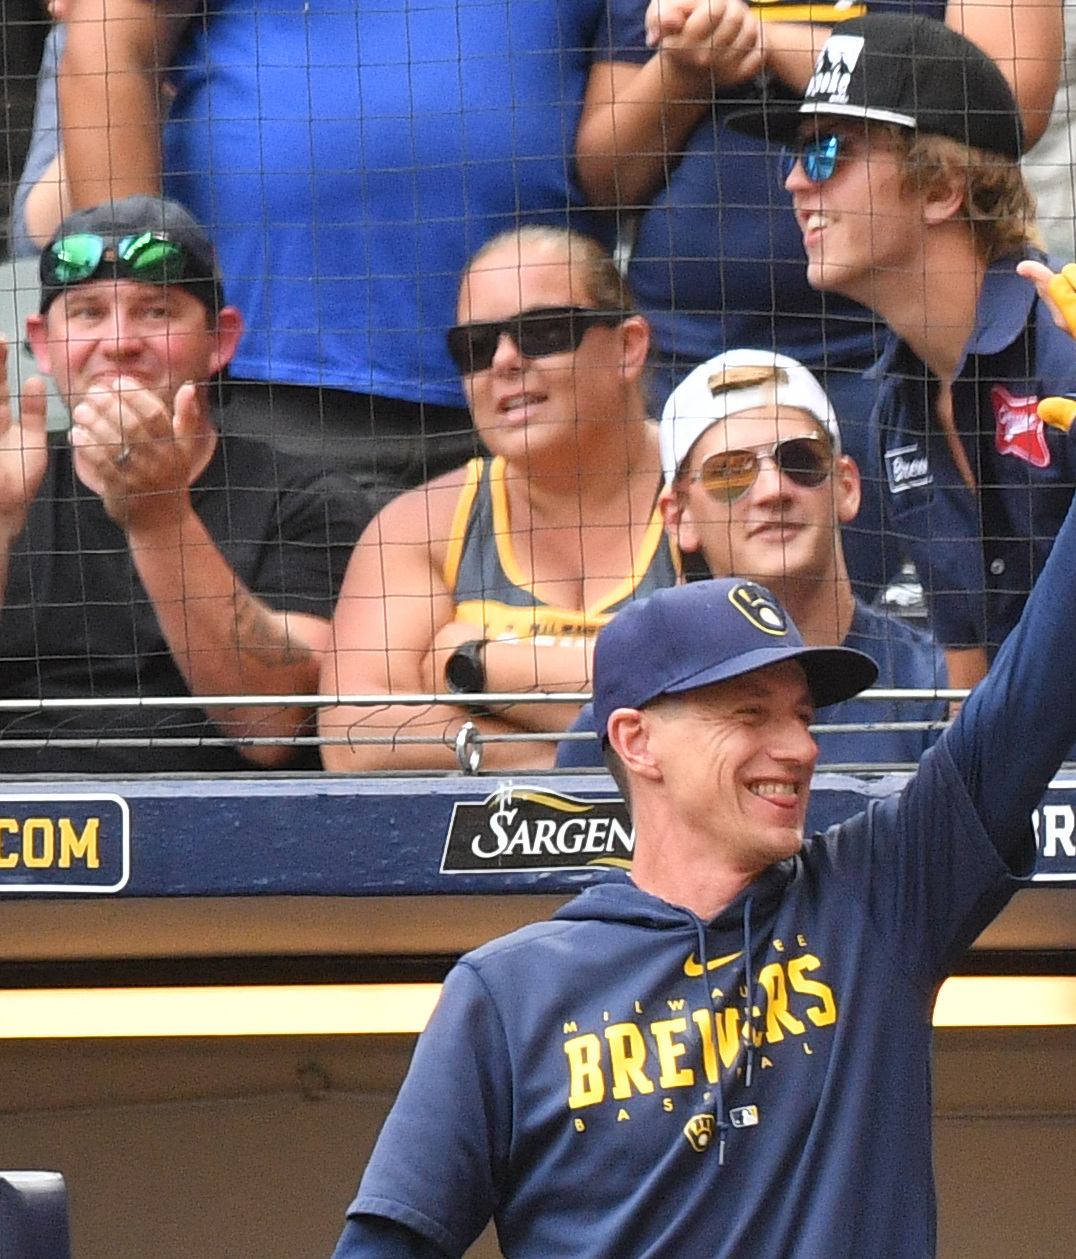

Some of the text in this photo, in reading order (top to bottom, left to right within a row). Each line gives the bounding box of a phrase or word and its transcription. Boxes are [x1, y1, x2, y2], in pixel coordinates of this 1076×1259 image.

[471, 807, 635, 858] SARGEN
[562, 934, 808, 1034] MILWAUEE
[563, 953, 837, 1110] BREWRS
